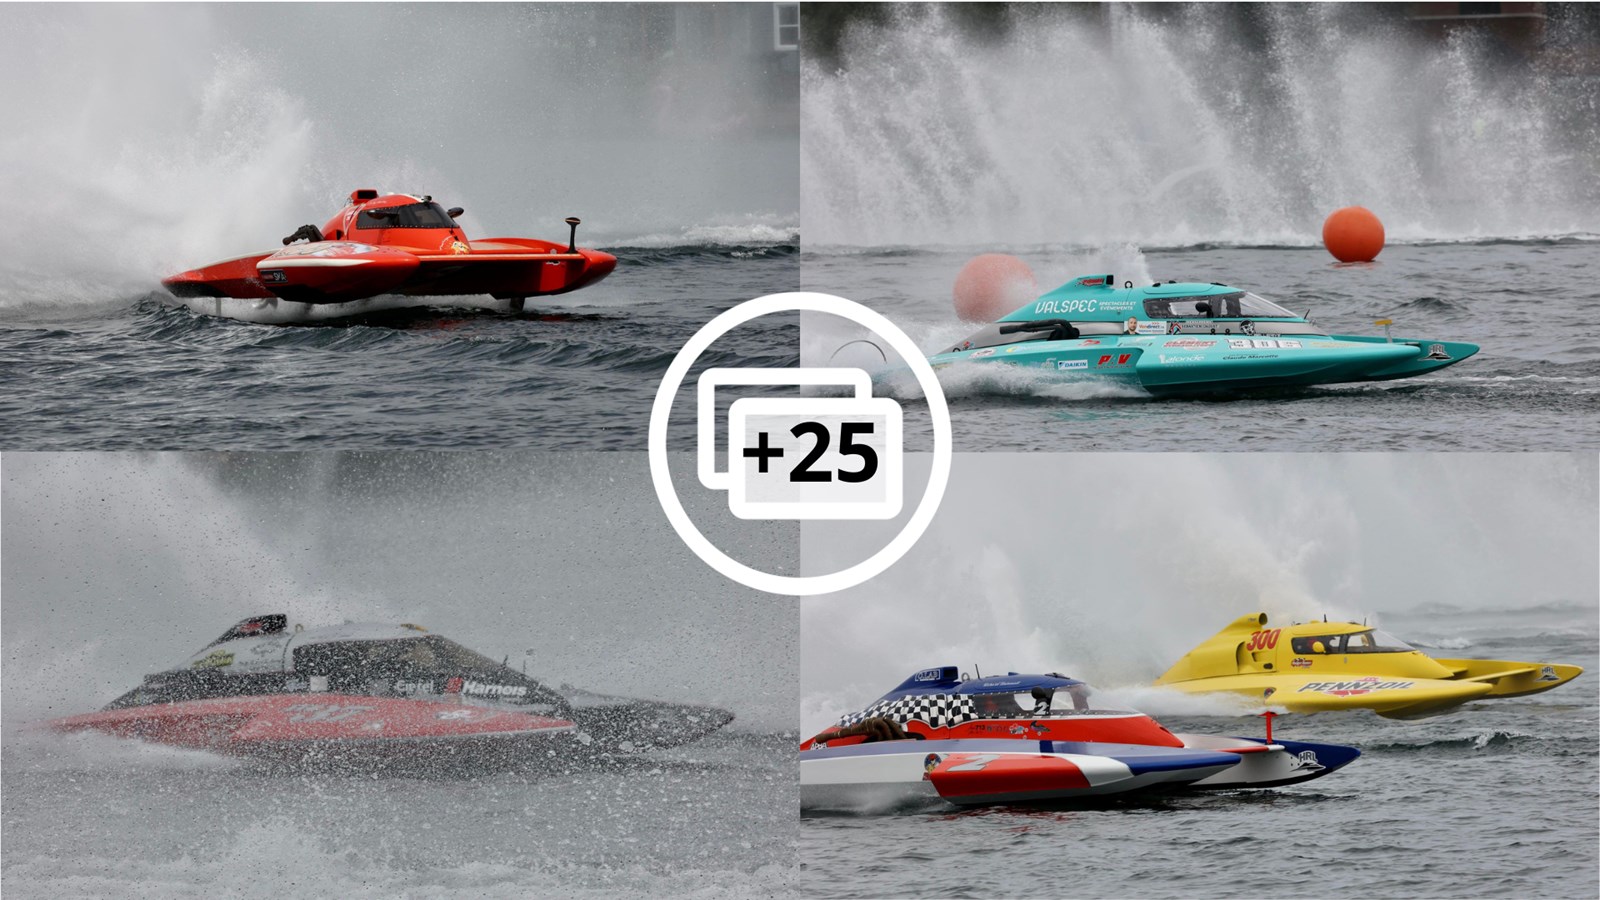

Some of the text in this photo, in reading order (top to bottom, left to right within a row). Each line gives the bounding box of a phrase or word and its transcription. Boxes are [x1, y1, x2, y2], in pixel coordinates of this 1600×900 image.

[1035, 299, 1097, 314] VALSPEC
[1246, 628, 1281, 651] 300
[462, 679, 528, 696] Harnois
[1298, 680, 1415, 693] PENNZOIL
[1034, 701, 1049, 715] 2
[1300, 751, 1317, 762] HRL
